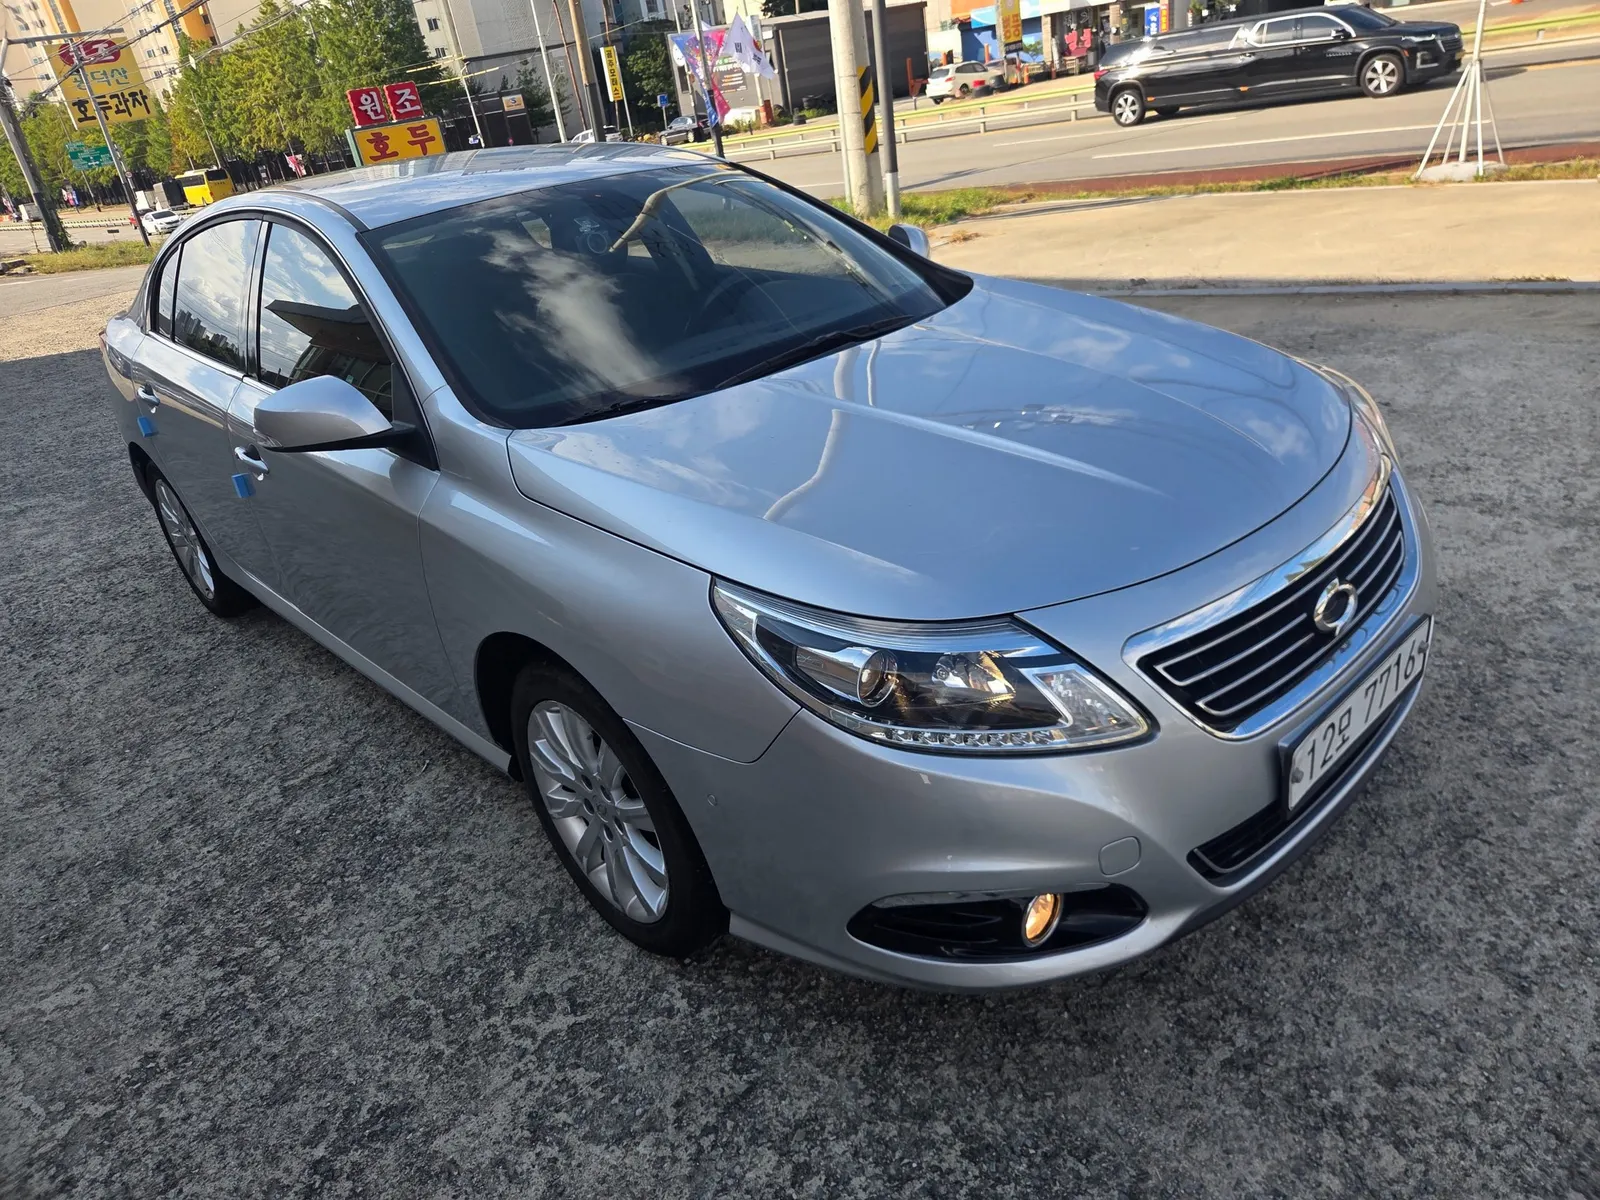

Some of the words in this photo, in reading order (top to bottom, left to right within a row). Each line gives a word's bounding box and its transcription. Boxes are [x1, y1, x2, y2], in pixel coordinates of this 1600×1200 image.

[72, 89, 151, 123] 호두과자
[358, 88, 422, 120] 원조
[366, 124, 436, 162] 호두
[1307, 706, 1352, 781] 12모
[1364, 639, 1416, 725] 7716
